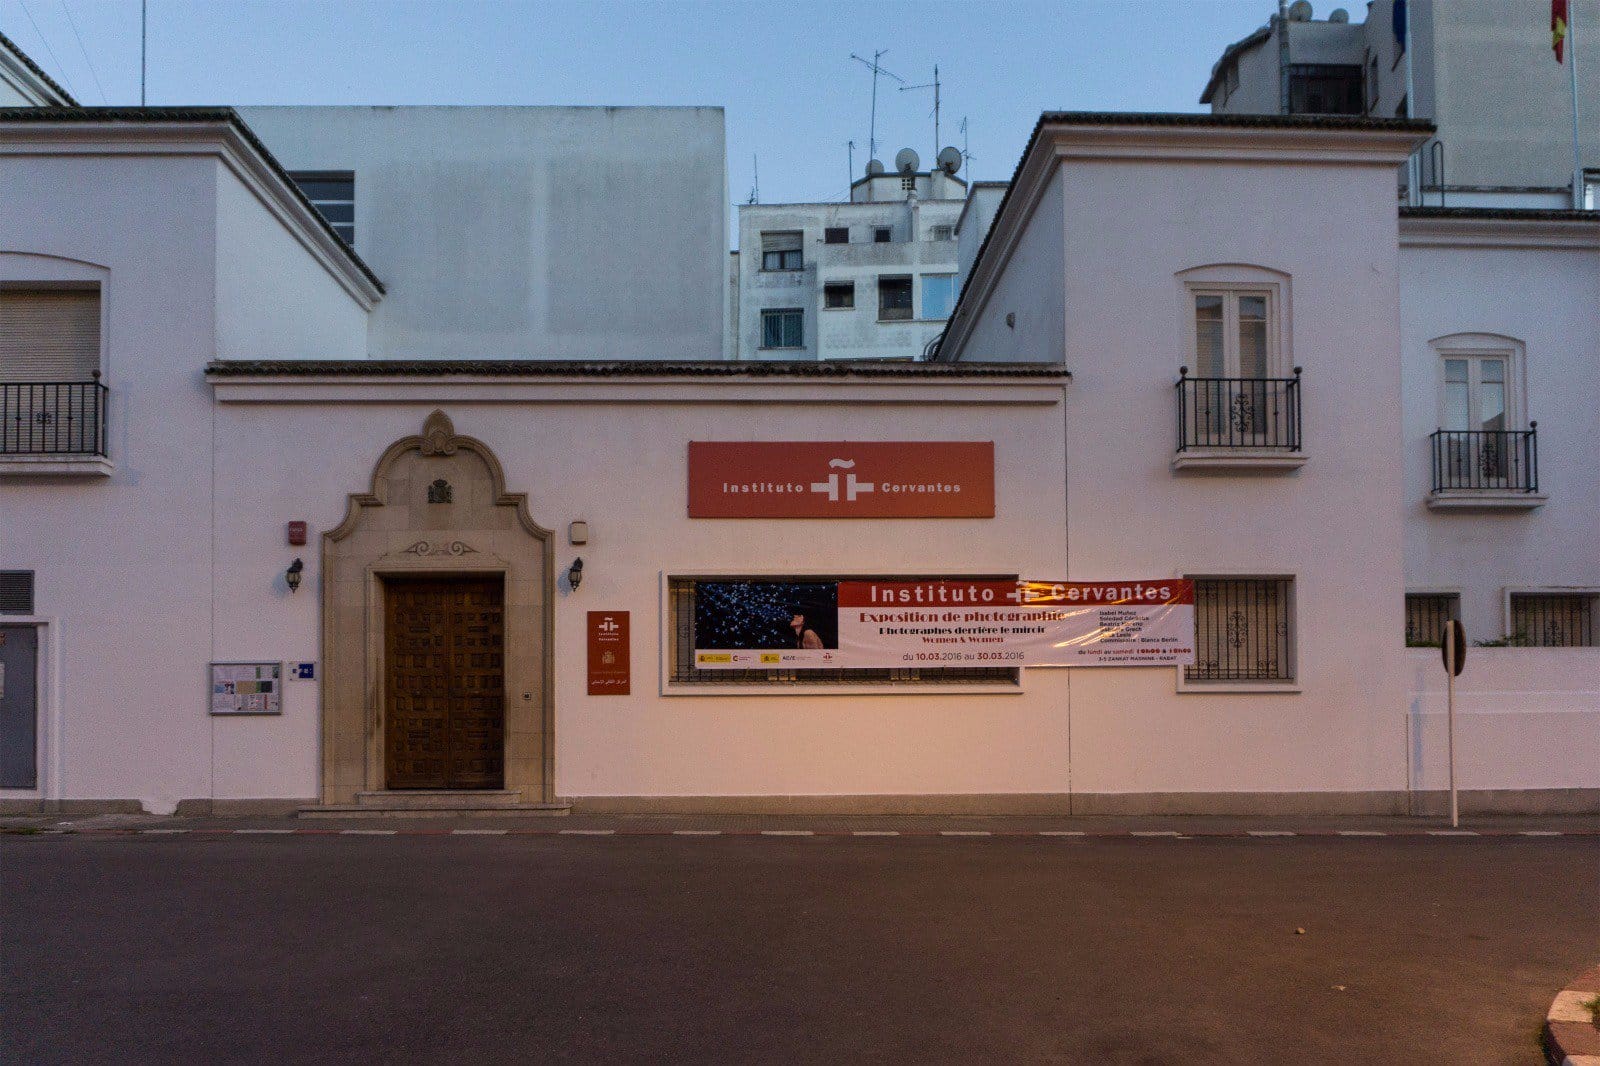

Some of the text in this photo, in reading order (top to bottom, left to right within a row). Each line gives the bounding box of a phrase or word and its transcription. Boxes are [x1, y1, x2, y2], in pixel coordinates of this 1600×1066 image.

[723, 482, 961, 493] Instituto Cervantes
[871, 583, 1171, 602] Instituto Cervantes
[860, 611, 1065, 623] Exposition de photographie
[879, 626, 1045, 636] Photographes derrière le miroir
[922, 636, 957, 644] Women
[960, 636, 965, 644] &
[903, 652, 914, 661] du
[916, 653, 961, 661] 10.03.2016
[977, 652, 1025, 661] 30.03.2016
